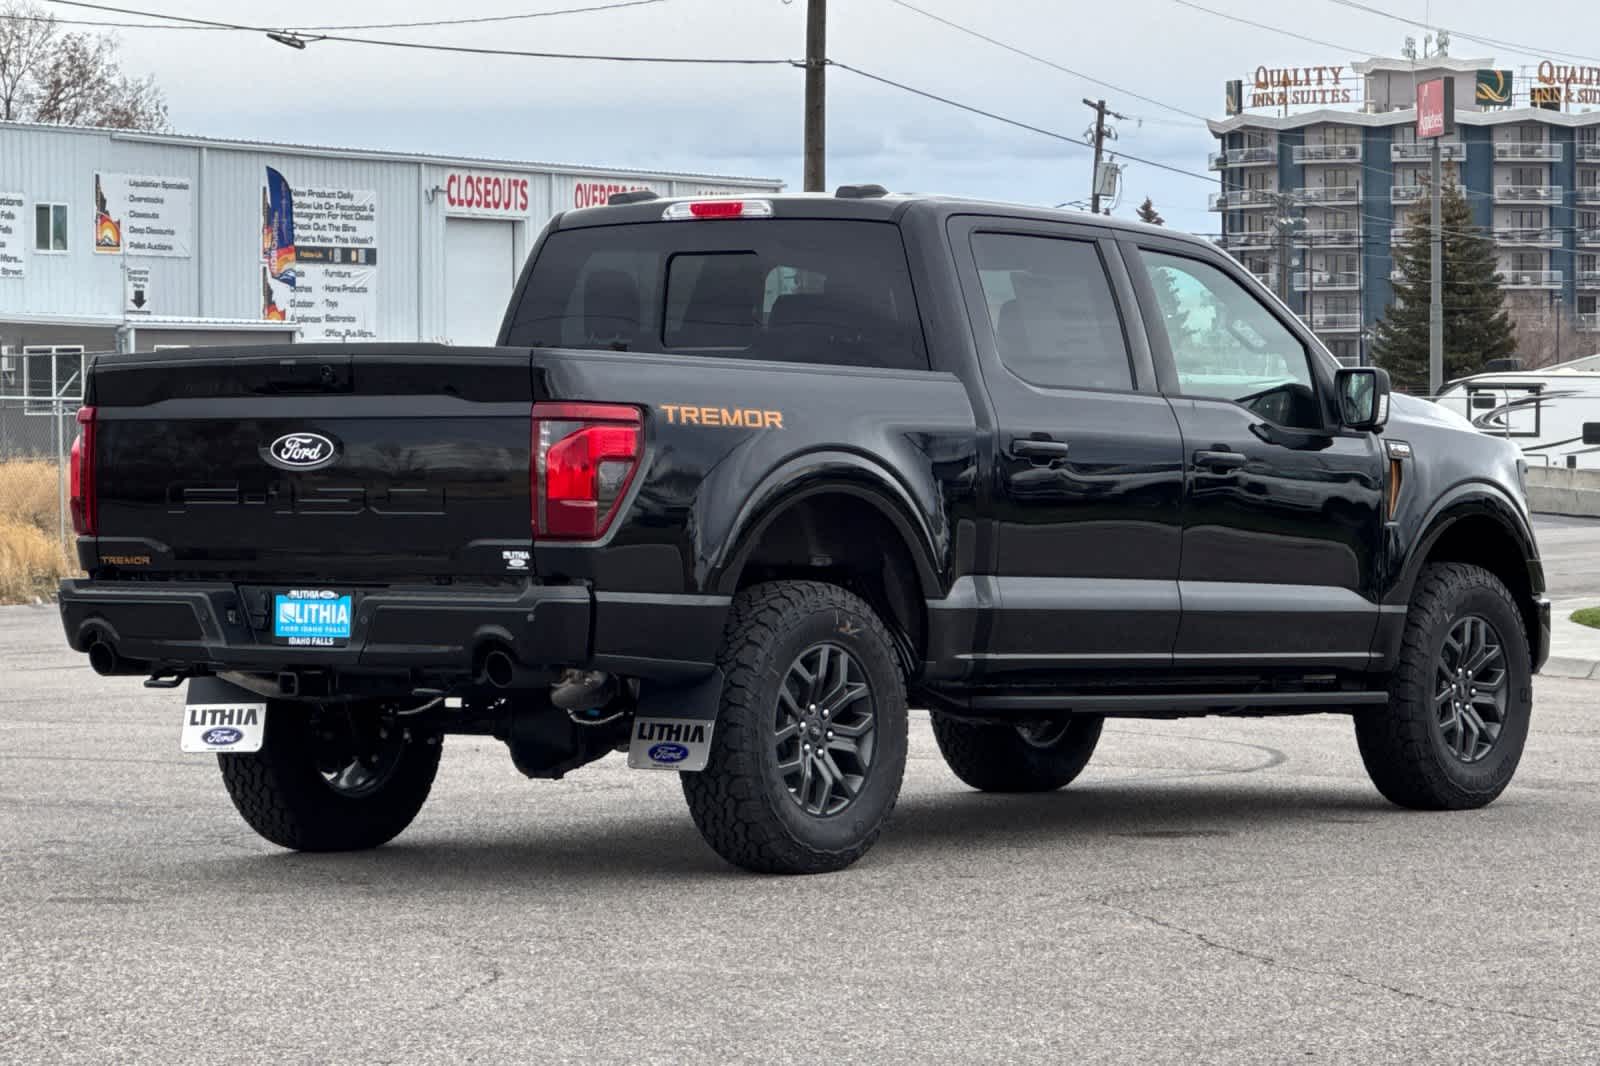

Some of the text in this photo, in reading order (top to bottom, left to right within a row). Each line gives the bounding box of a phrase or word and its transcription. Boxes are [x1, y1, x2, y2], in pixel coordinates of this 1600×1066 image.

[1256, 65, 1344, 89] QUALITY
[1252, 92, 1275, 107] INN
[1292, 88, 1350, 104] SUITES
[1534, 87, 1561, 104] INN
[307, 189, 336, 199] Product
[337, 191, 354, 201] Daily
[447, 174, 528, 211] CLOSEOUTS
[313, 202, 323, 210] Us
[336, 203, 368, 212] Facebook
[341, 213, 354, 221] Hot
[355, 213, 374, 221] Deals
[313, 223, 327, 231] Out
[328, 223, 341, 231] The
[341, 224, 357, 232] Bins
[317, 235, 333, 243] New
[147, 242, 174, 251] Auctions
[325, 269, 351, 278] Furniture
[342, 285, 368, 293] Products
[325, 299, 338, 308] Toys
[325, 314, 357, 322] Electronics
[660, 404, 783, 428] TREMOR
[281, 437, 322, 459] Ford
[101, 556, 150, 565] TREMOR
[296, 590, 320, 599] LITHIA
[296, 604, 348, 624] LITHIA
[288, 637, 334, 645] IDAHO FALLS
[190, 709, 258, 725] LITHIA
[206, 729, 239, 744] Ford
[638, 723, 704, 742] LITHIA
[653, 745, 685, 759] Ford
